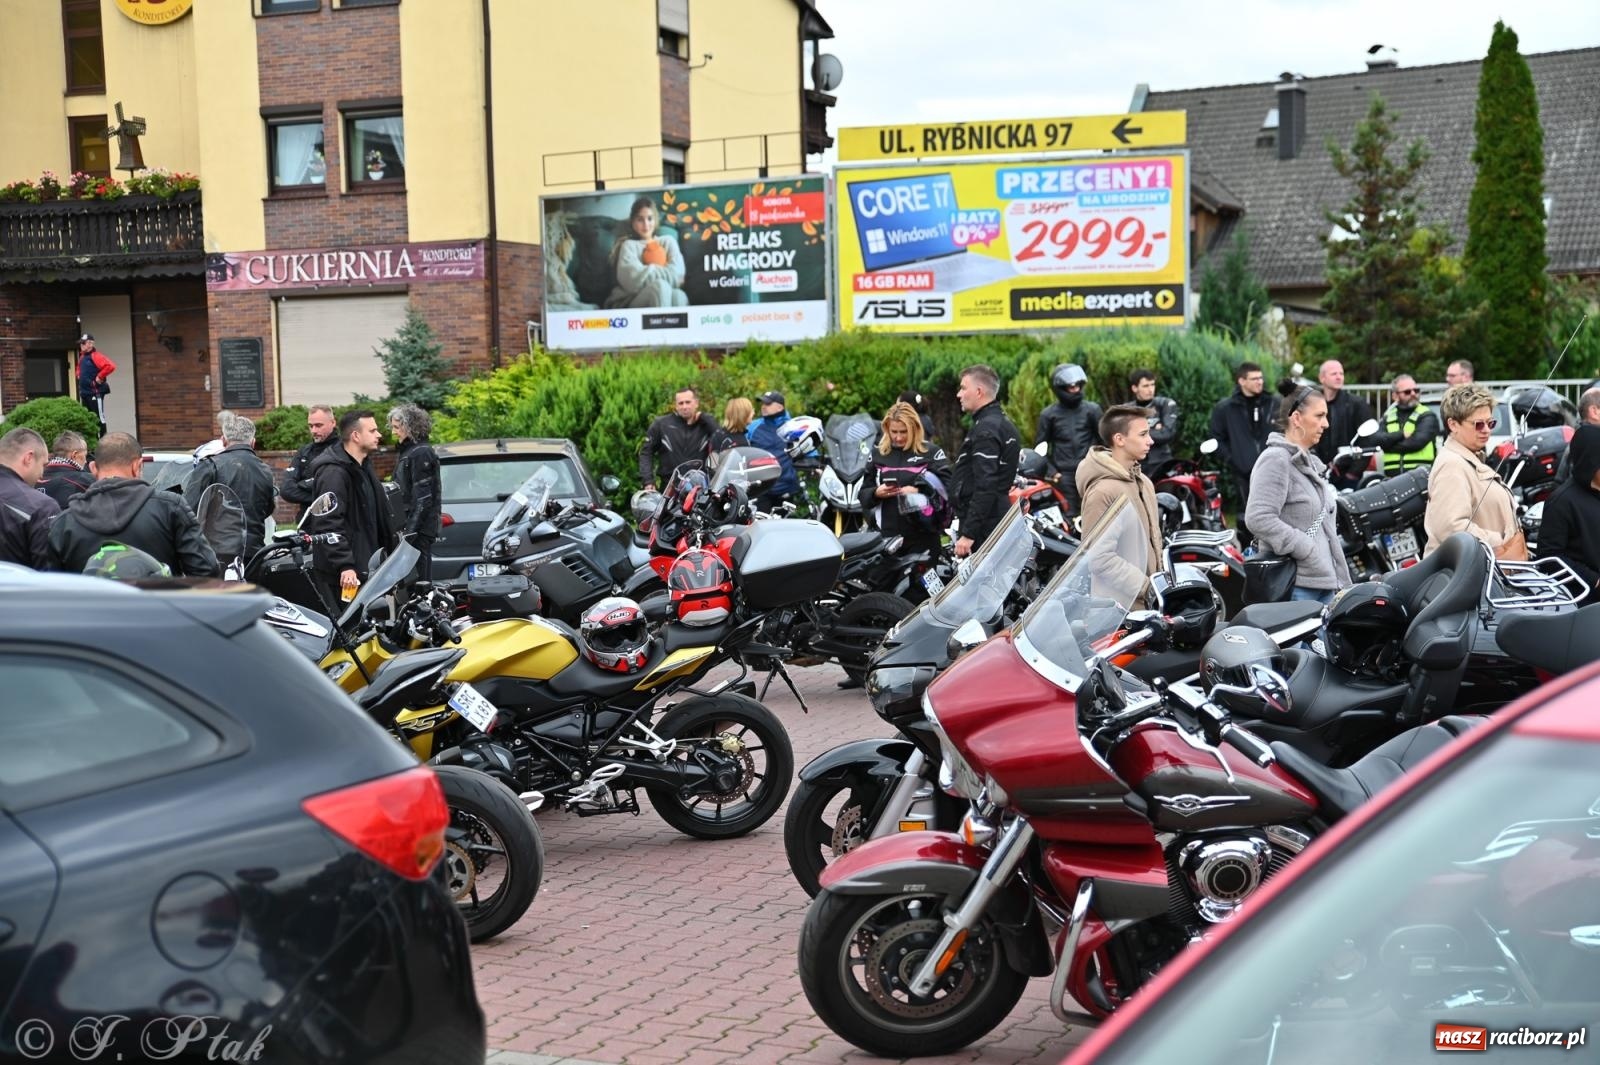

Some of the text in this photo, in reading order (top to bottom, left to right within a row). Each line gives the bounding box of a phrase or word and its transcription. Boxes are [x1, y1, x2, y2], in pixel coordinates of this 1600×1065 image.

[880, 123, 1073, 154] UL. RYBNICKA 97
[1003, 165, 1166, 194] PRZECENY!
[857, 182, 949, 219] CORE i7
[1082, 192, 1167, 206] NA URODZINY
[958, 211, 997, 224] RATY
[717, 230, 782, 251] RELAKS
[886, 222, 948, 246] Windows 11
[953, 225, 987, 244] 0%
[246, 247, 417, 285] CUKIERNIA
[703, 249, 797, 272] I NAGRODY
[708, 278, 719, 288] w
[756, 273, 793, 285] Auchan
[857, 274, 930, 289] 16 GB RAM
[858, 299, 946, 319] ASUS
[701, 315, 721, 325] plus
[457, 689, 476, 710] SRC
